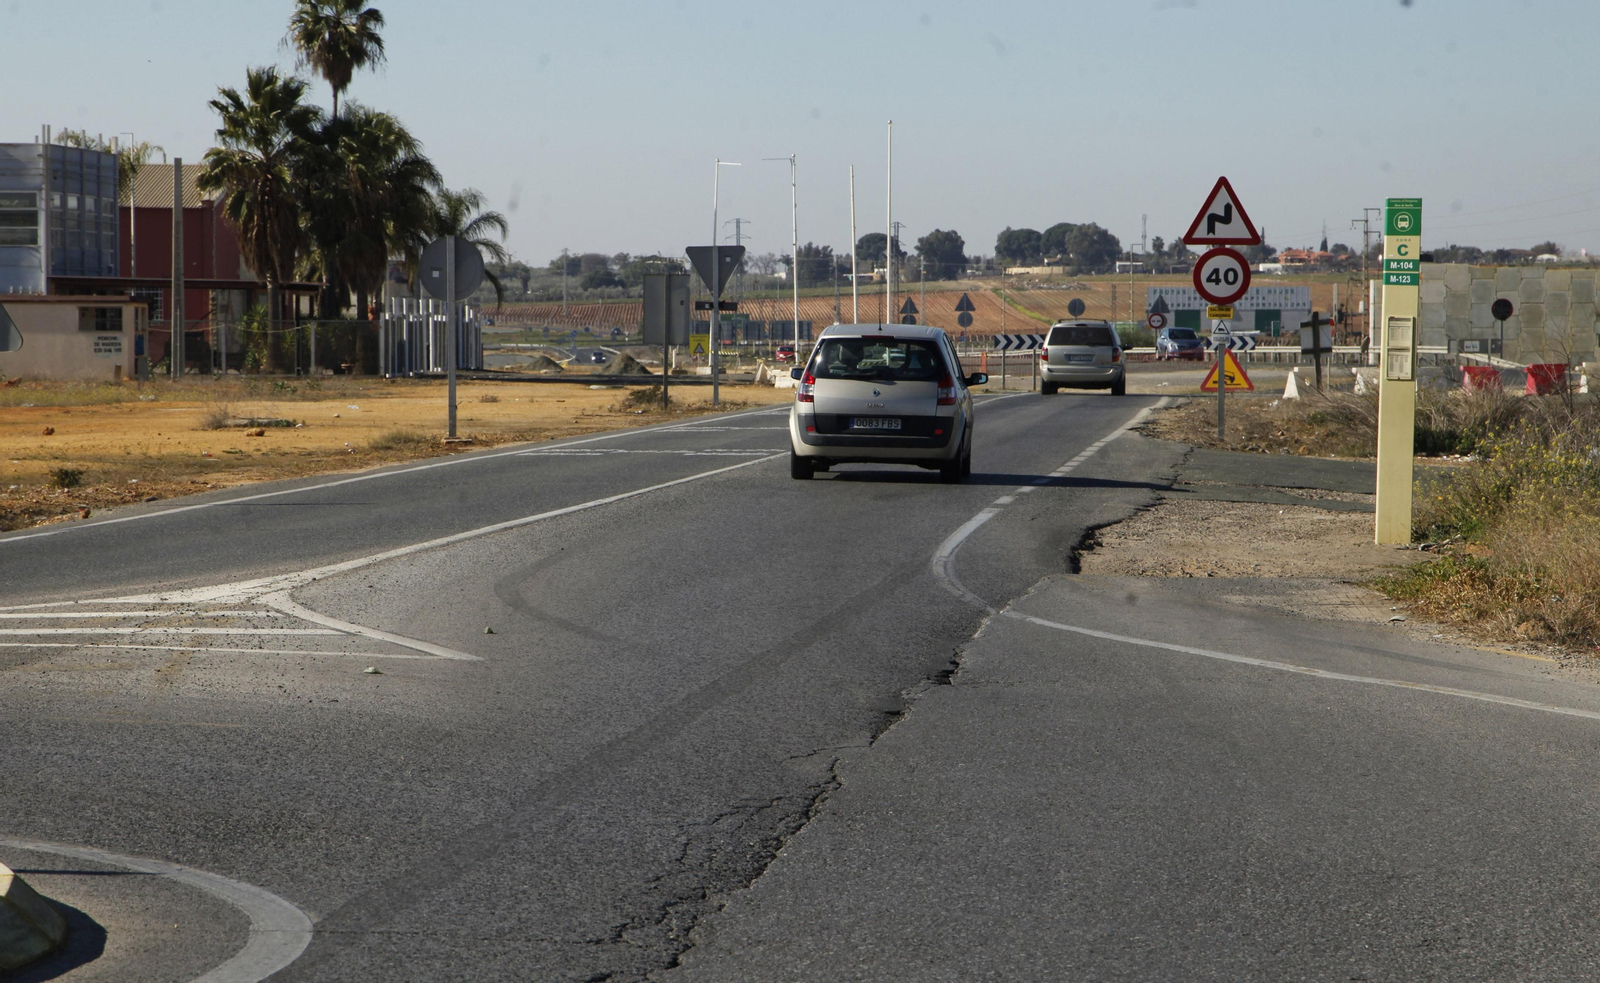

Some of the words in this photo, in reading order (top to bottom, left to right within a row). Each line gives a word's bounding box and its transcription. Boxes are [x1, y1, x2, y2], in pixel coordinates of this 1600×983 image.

[1397, 244, 1409, 257] C
[1390, 261, 1413, 269] M-104
[1206, 267, 1238, 286] 40
[1390, 275, 1411, 283] M-123
[856, 418, 880, 427] 0083
[882, 419, 899, 428] FBS
